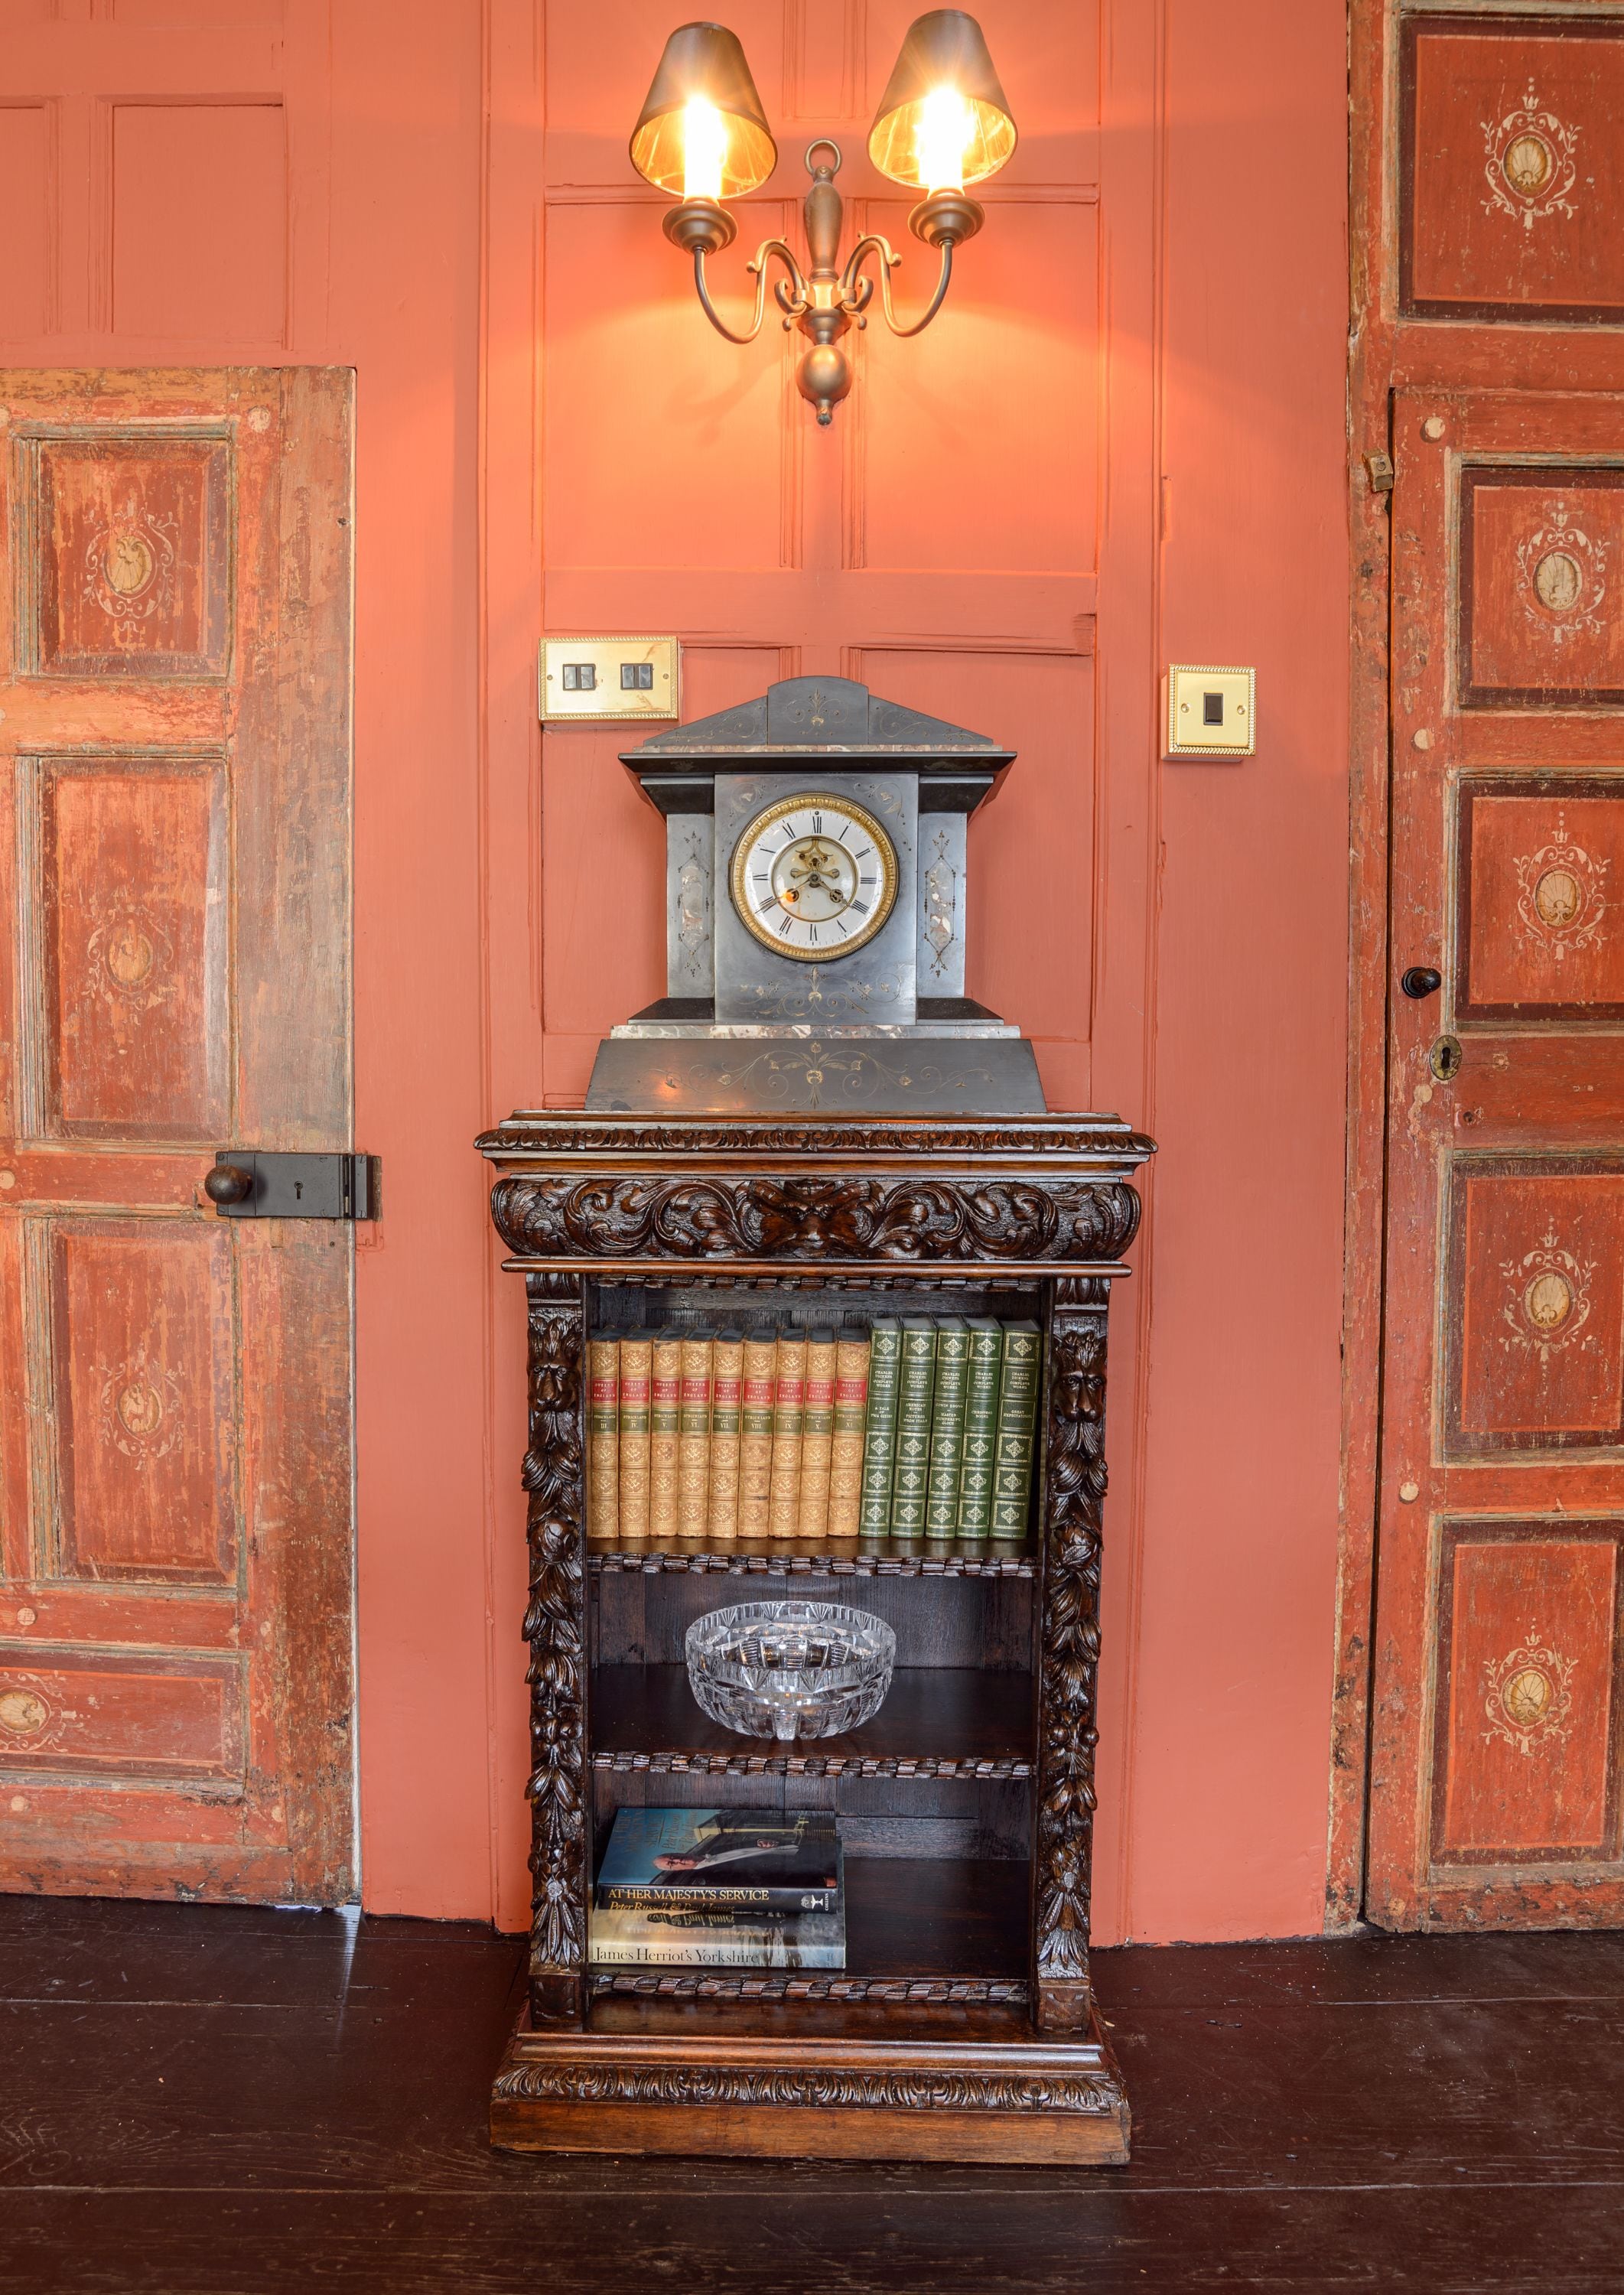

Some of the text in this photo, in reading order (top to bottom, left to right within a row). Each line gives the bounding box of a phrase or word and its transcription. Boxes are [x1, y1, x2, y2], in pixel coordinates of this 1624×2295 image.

[812, 816, 822, 834] XII
[854, 848, 871, 859] II
[809, 923, 818, 941] VI
[608, 1889, 770, 1901] AT HER MAJESTY'S SERVICE
[610, 1901, 633, 1910] Peter
[634, 1902, 668, 1910] Russell
[683, 1903, 705, 1911] Paul
[706, 1903, 735, 1912] James
[594, 1947, 759, 1963] James Herriot's Yorkshire
